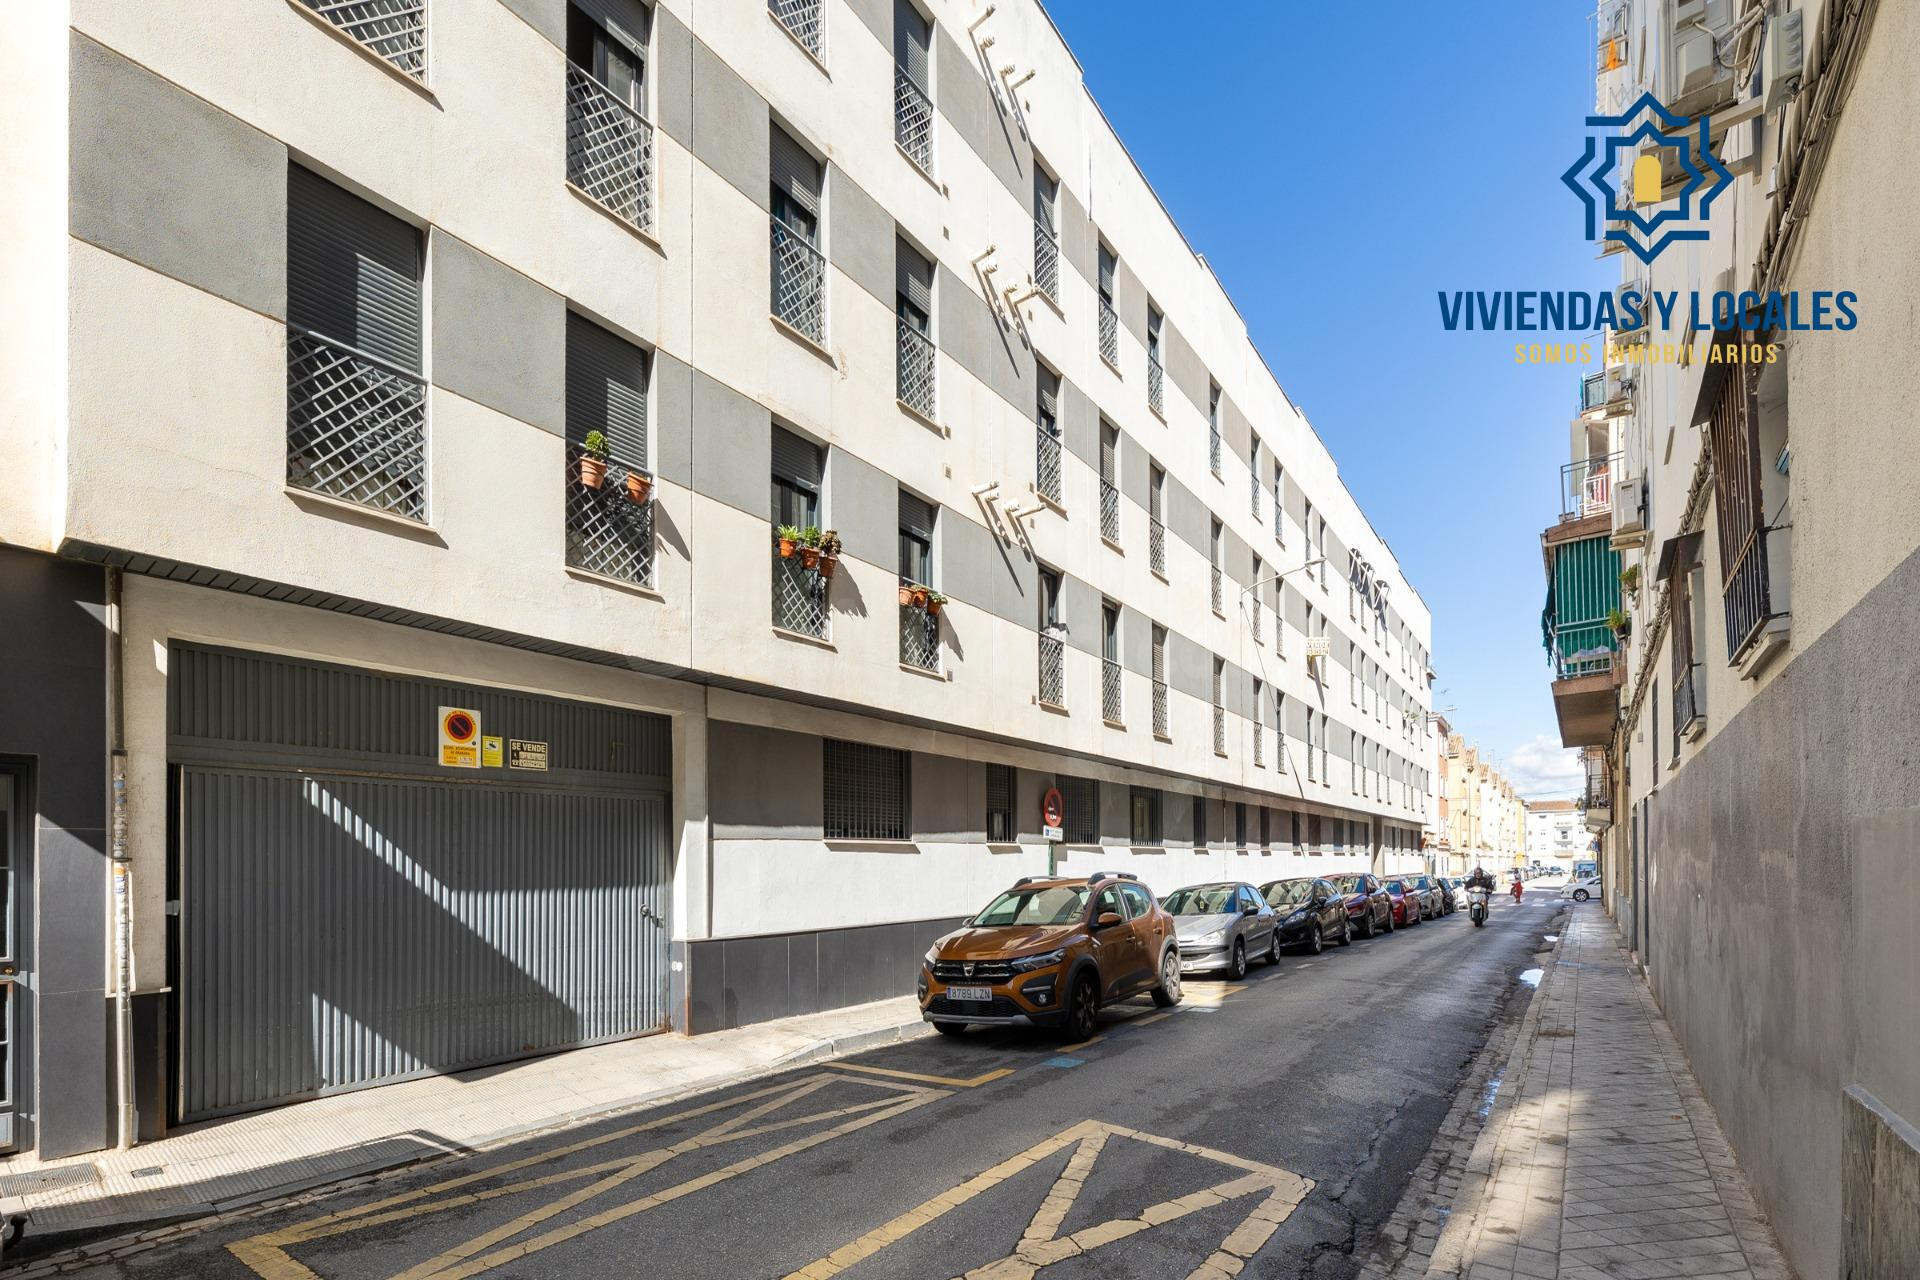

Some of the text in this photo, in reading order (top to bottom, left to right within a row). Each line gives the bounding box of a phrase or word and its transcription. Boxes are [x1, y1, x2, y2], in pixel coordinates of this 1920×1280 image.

[511, 742, 546, 752] SE VENDE
[951, 988, 972, 999] 8789
